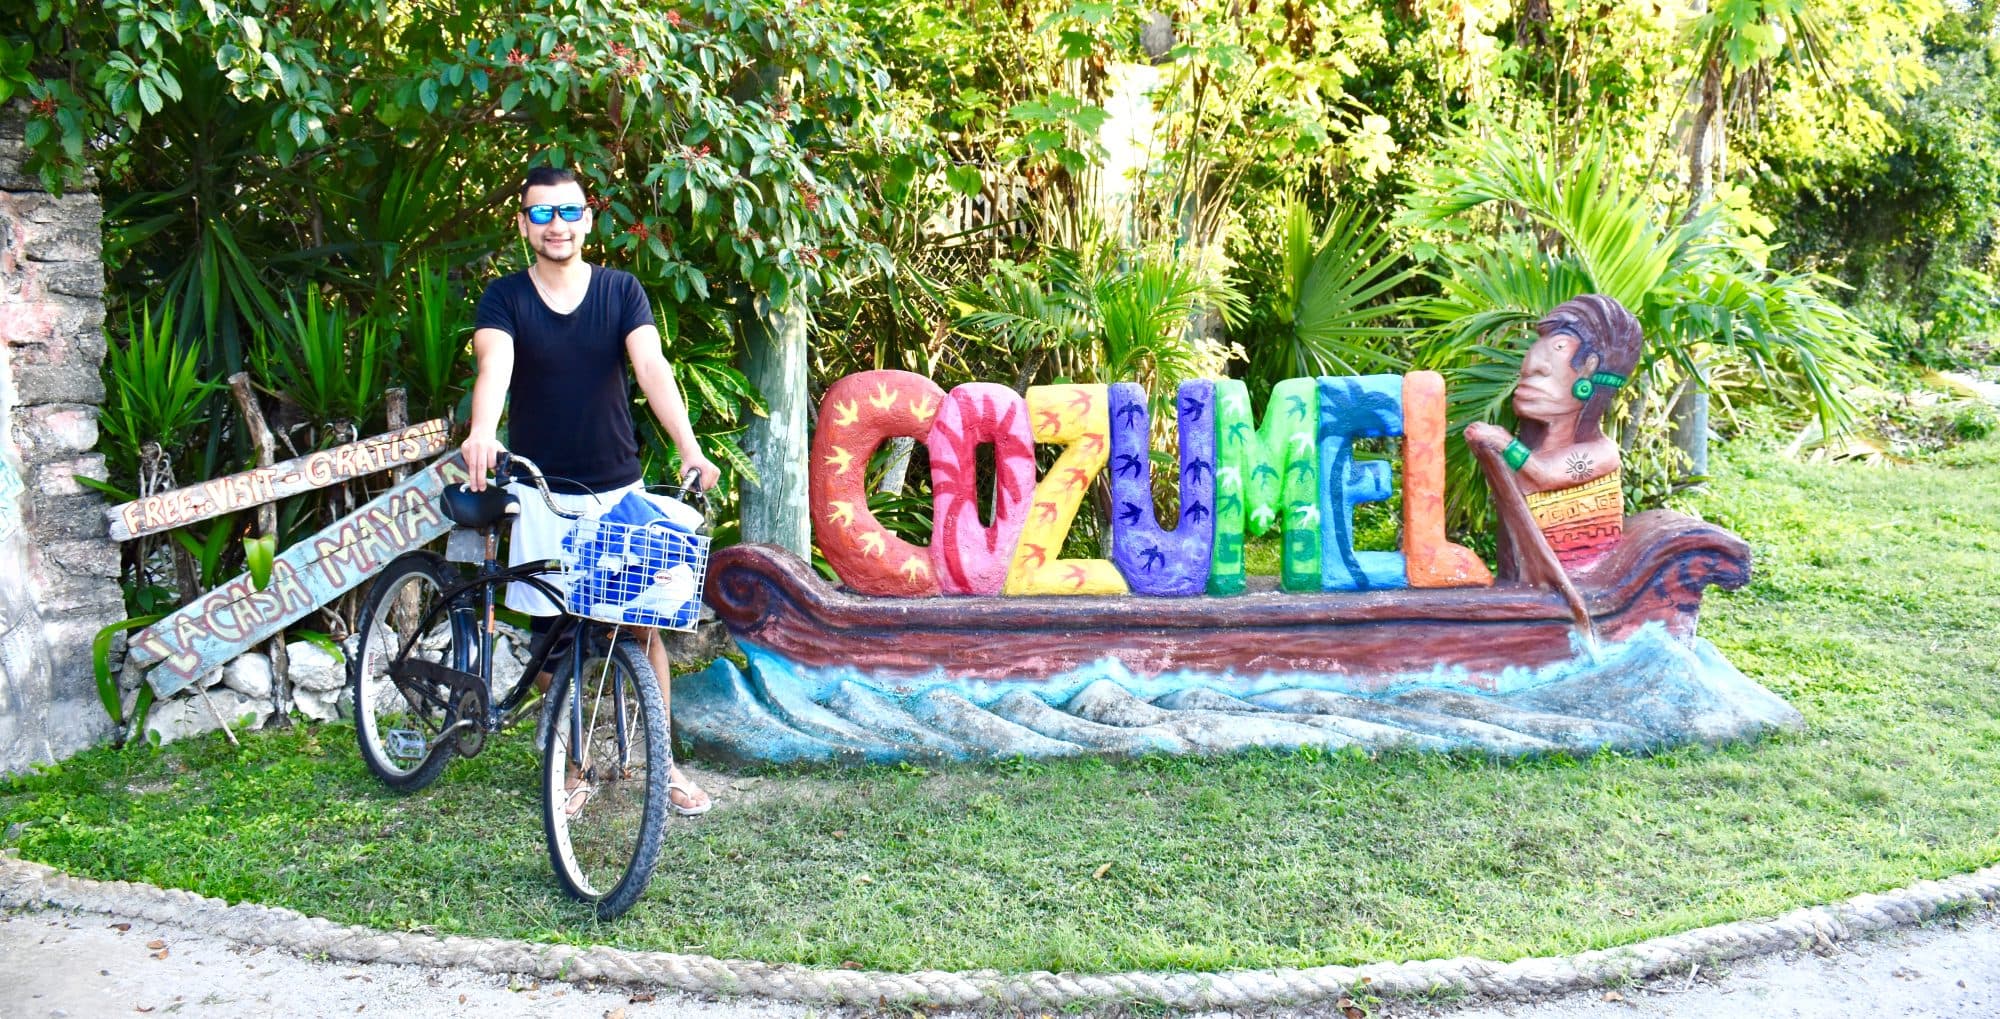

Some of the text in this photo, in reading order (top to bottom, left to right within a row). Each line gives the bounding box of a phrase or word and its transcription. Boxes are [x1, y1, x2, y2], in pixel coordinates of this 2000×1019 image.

[205, 469, 277, 513] VISIT
[809, 369, 1494, 597] COZUMEL
[140, 486, 440, 680] LA CASA MAYA
